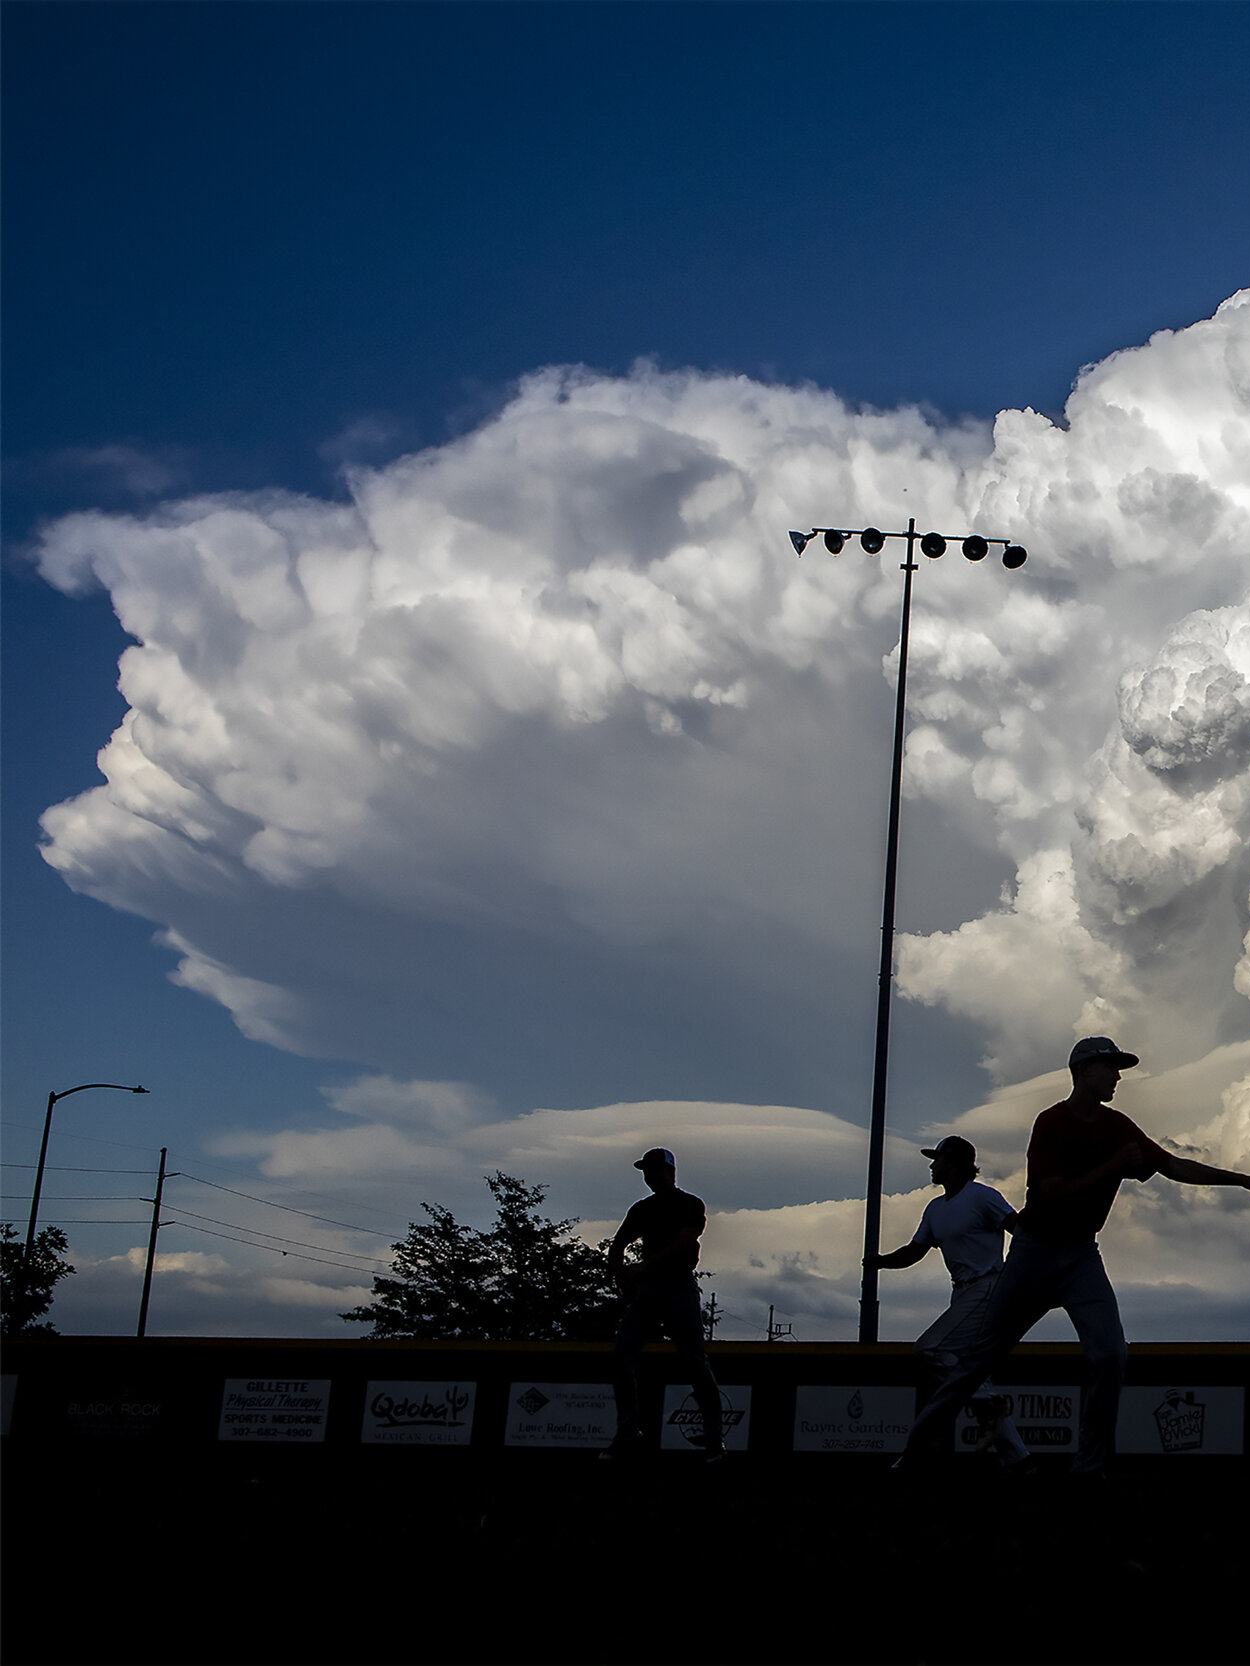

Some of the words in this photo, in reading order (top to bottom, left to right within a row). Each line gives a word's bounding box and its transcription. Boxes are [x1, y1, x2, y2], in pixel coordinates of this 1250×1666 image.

[246, 1382, 309, 1393] GILLETTE
[226, 1394, 276, 1410] Physical
[277, 1394, 322, 1411] Therapy
[371, 1393, 449, 1424] Qdoba
[1018, 1394, 1072, 1420] TIMES
[67, 1403, 112, 1416] BLACK
[120, 1403, 161, 1416] ROCK
[224, 1414, 266, 1424] SPORTS
[272, 1415, 322, 1425] MEDICINE
[587, 1424, 606, 1434] Inc.
[800, 1420, 844, 1435] Rayne
[848, 1418, 909, 1434] Gardens
[374, 1432, 421, 1441] MEXICAN
[429, 1432, 458, 1442] GRILL
